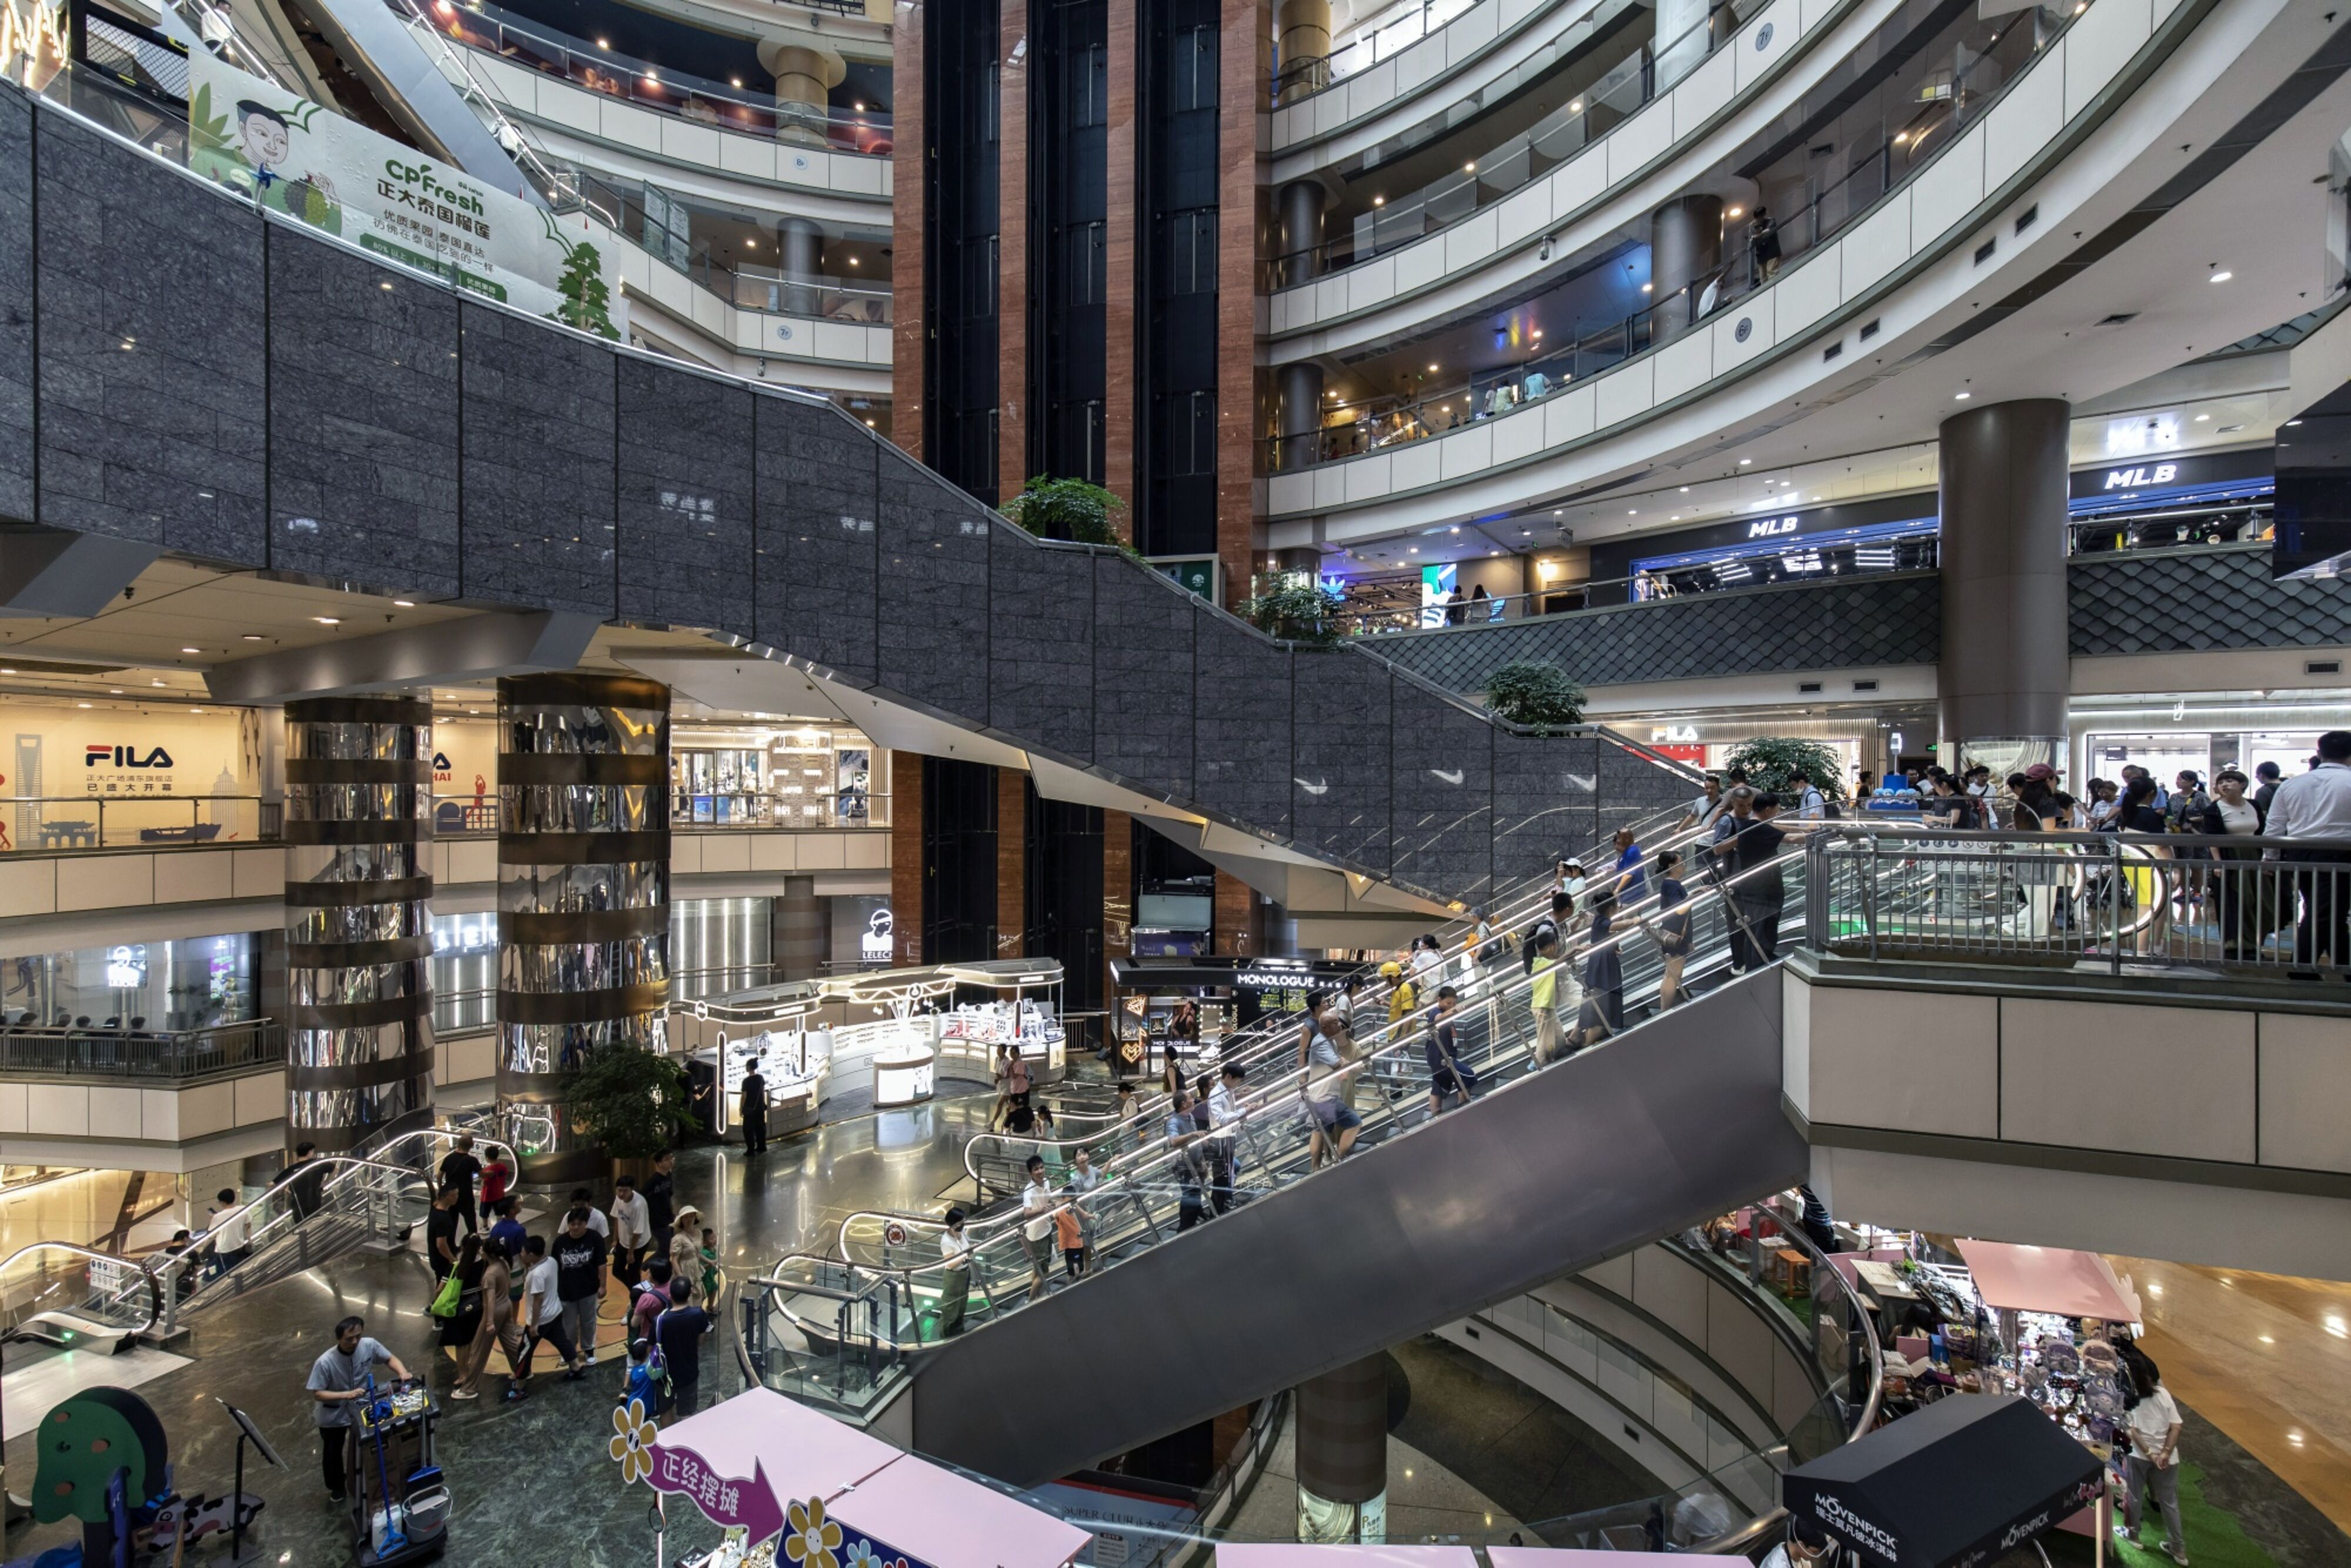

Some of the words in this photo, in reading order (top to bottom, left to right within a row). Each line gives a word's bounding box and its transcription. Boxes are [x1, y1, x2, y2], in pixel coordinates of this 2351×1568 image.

[378, 178, 490, 240] 正大泰国榴莲
[2104, 464, 2177, 489] MLB
[1749, 517, 1798, 538] MLB
[1652, 726, 1698, 741] FILA
[86, 745, 173, 767] FILA
[88, 783, 172, 791] 已盛大开幕
[1237, 974, 1315, 988] MONOLOGUE
[663, 1451, 739, 1517] 正经摆摊
[1064, 1505, 1098, 1520] SUPER
[1815, 1505, 1897, 1563] 瑞士莫凡彼冰淇淋
